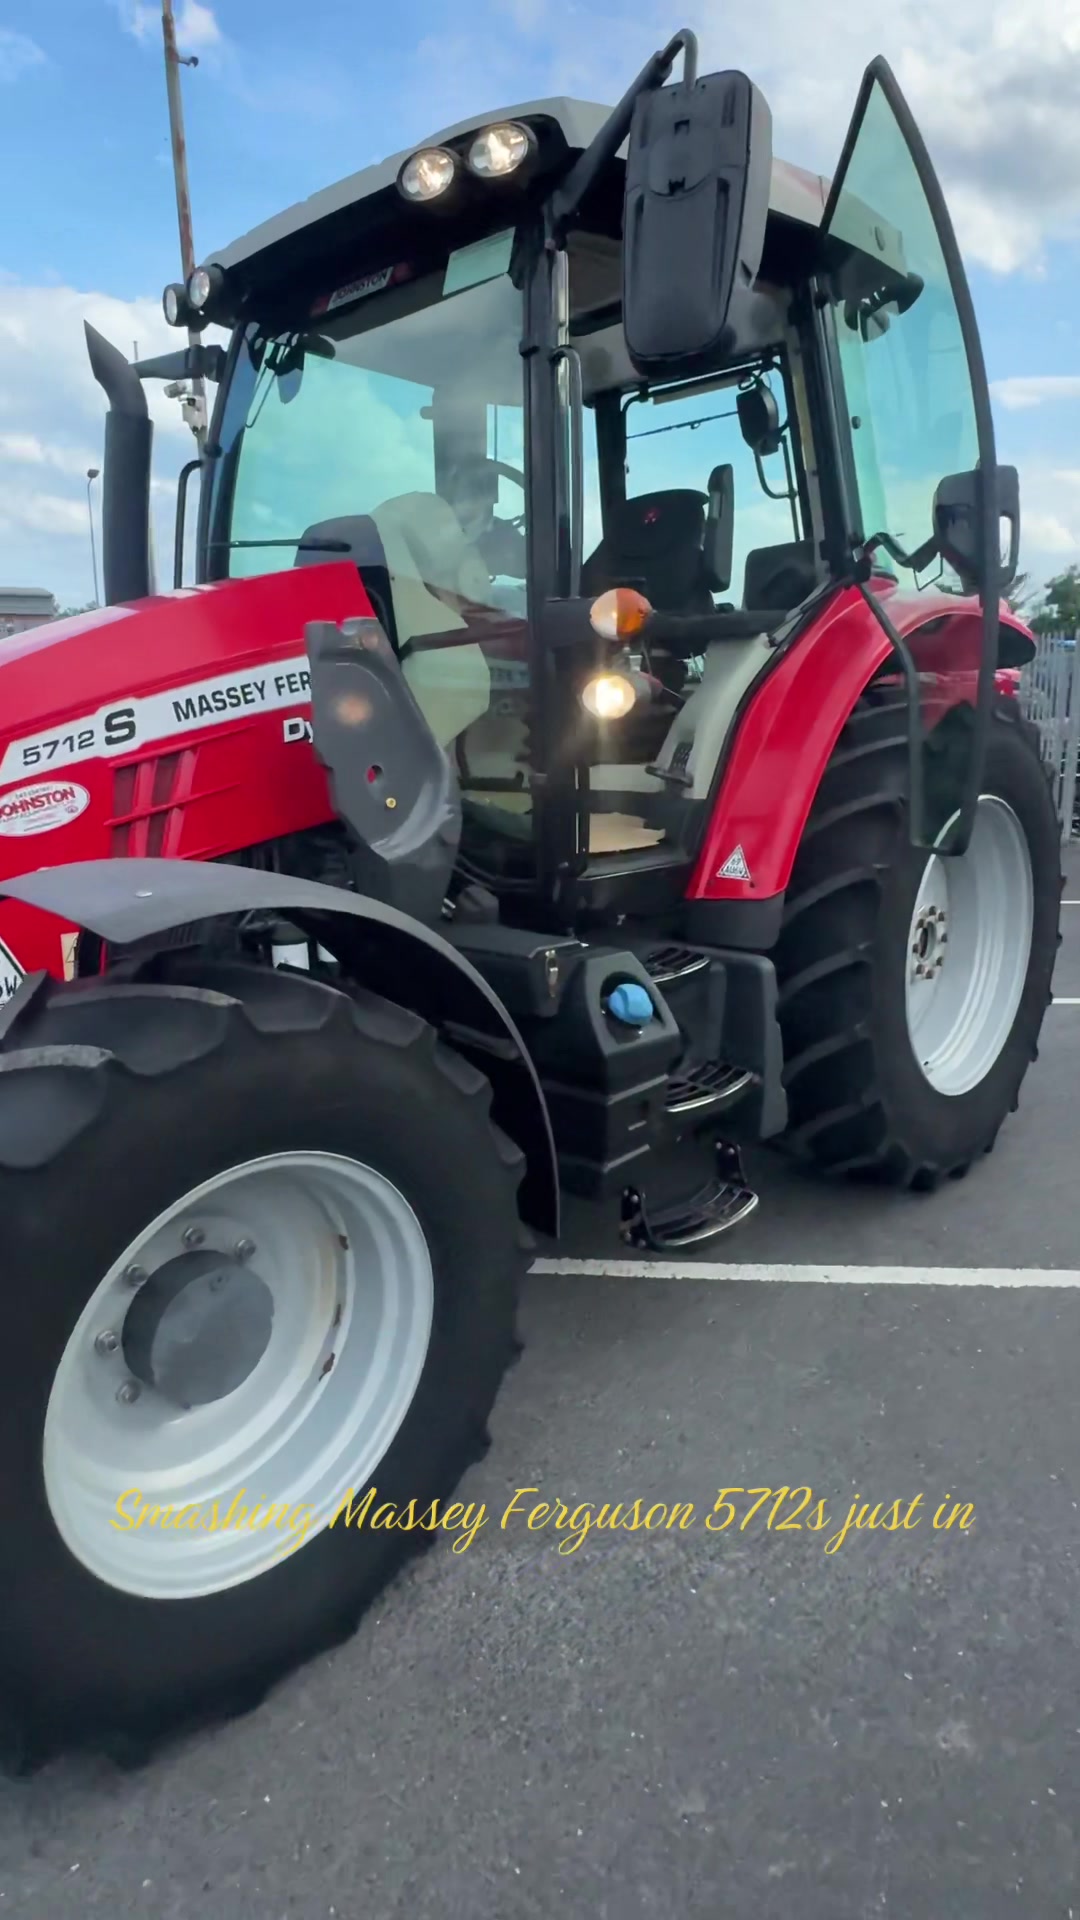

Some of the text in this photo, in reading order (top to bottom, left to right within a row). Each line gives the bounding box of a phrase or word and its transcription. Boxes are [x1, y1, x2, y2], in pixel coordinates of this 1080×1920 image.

[172, 679, 266, 723] MASSEY
[22, 707, 136, 767] 5712 S
[0, 786, 76, 819] OHNSTON
